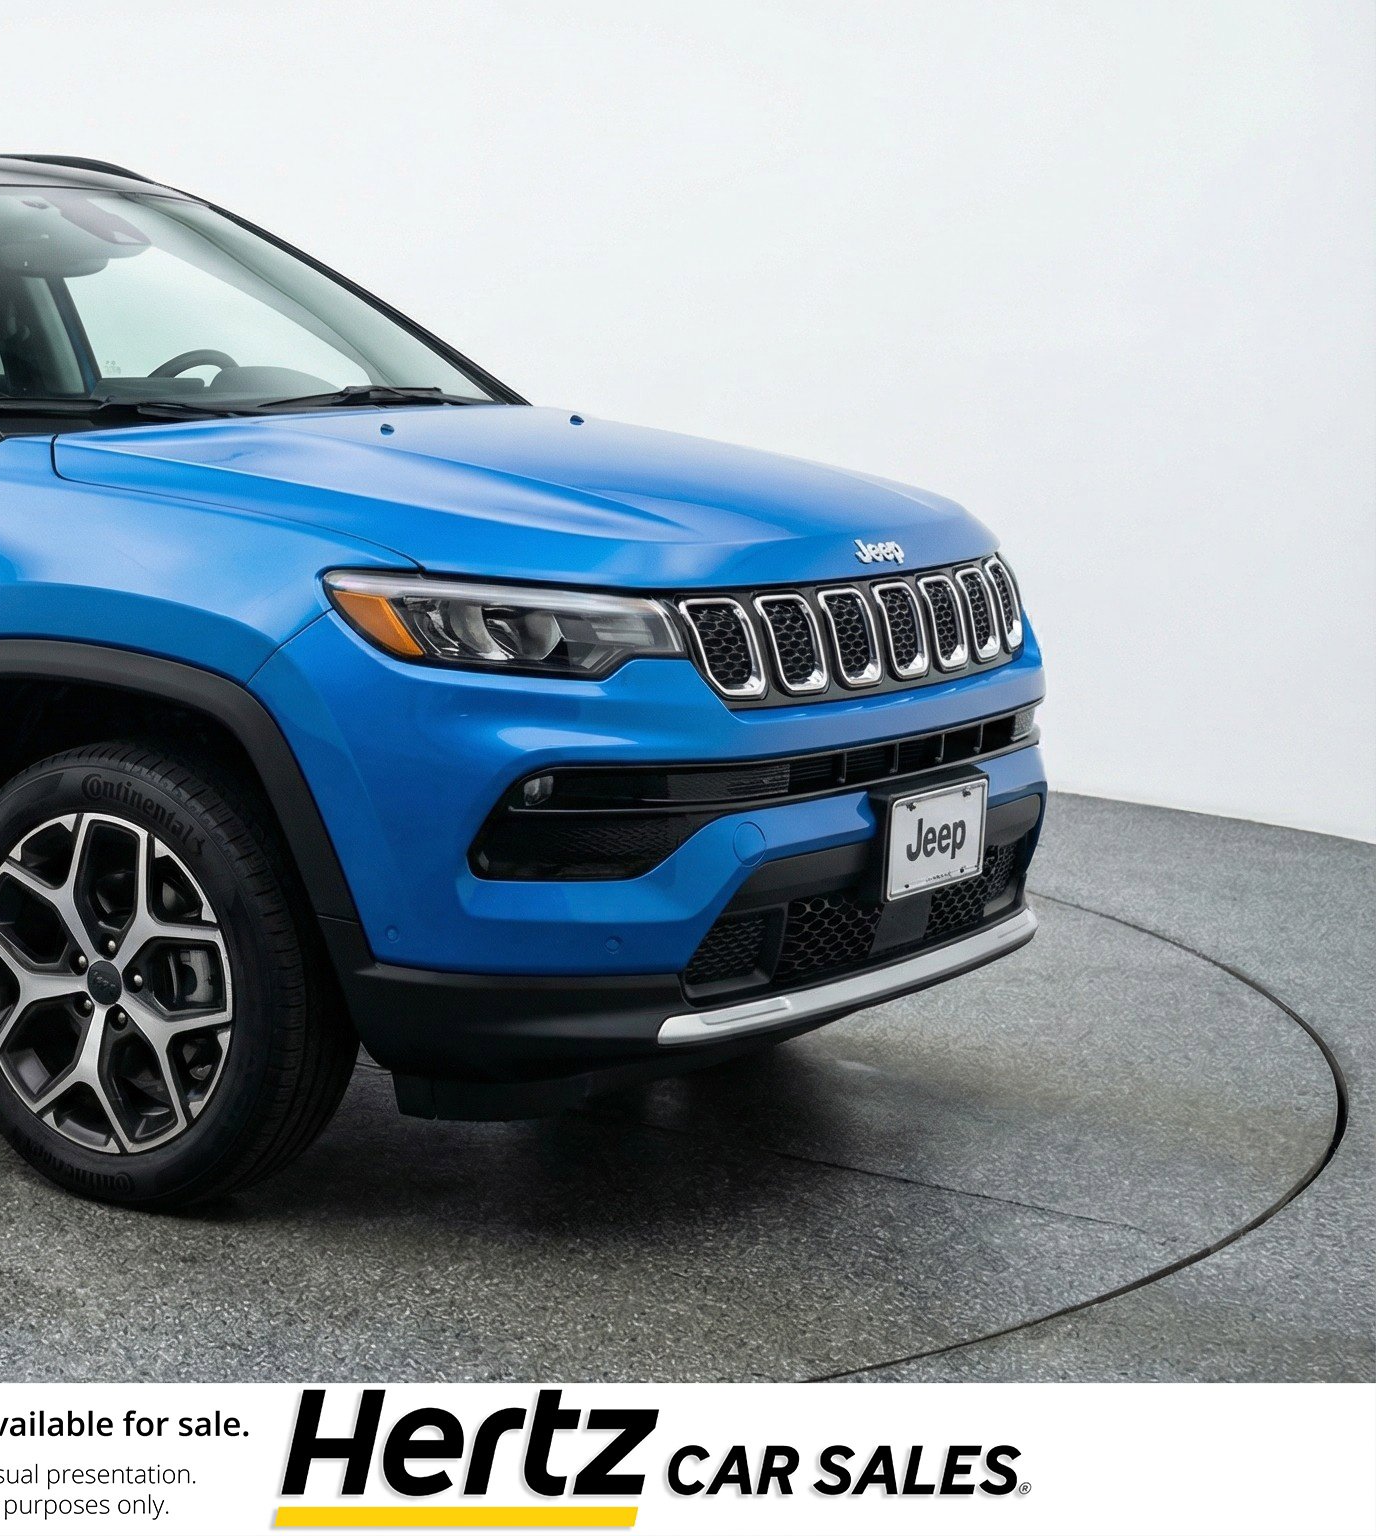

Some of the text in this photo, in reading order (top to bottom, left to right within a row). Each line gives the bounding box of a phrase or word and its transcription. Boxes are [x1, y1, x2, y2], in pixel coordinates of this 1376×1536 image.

[854, 539, 904, 564] Jeep
[82, 773, 194, 840] Continental
[906, 818, 966, 861] Jeep
